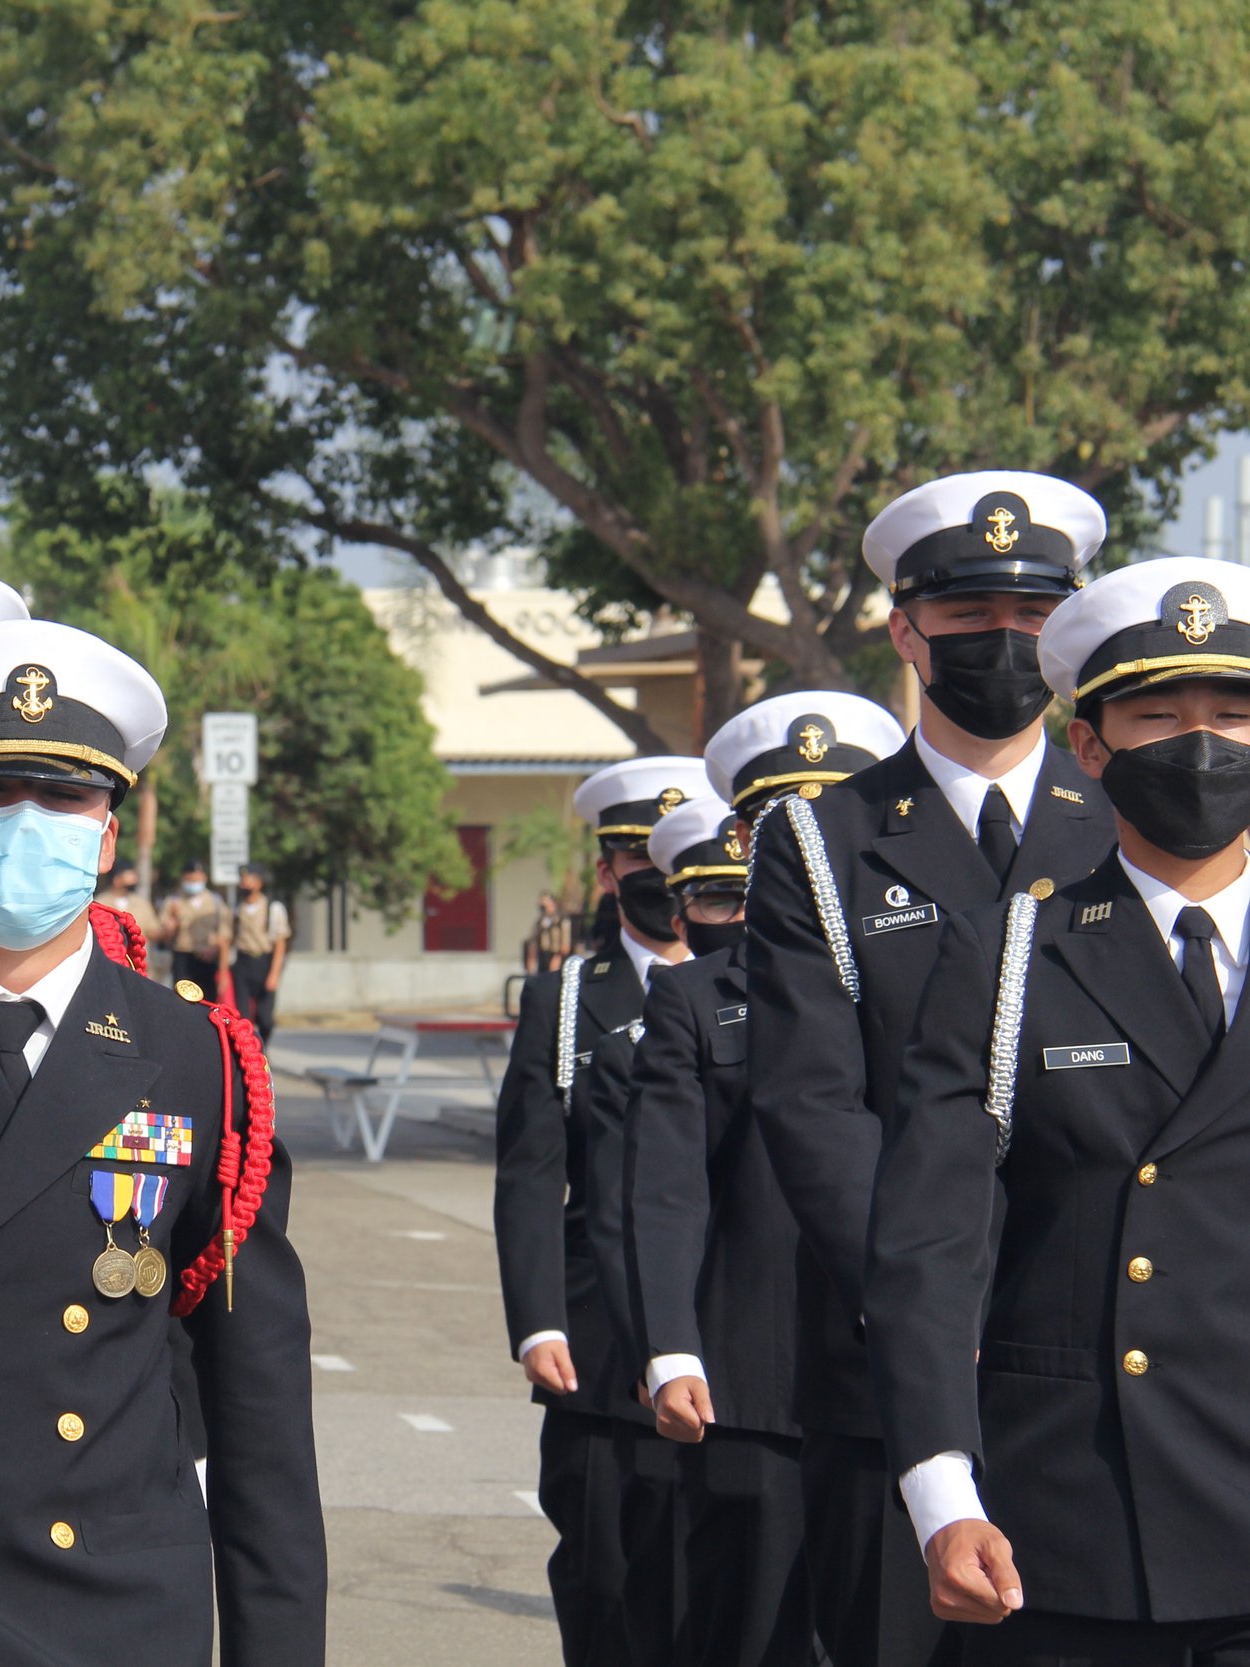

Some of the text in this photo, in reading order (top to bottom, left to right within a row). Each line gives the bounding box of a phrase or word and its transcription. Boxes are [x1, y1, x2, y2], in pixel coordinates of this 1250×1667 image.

[214, 750, 245, 775] 10
[874, 909, 926, 929] BOWMAN
[1070, 1049, 1105, 1063] DANG
